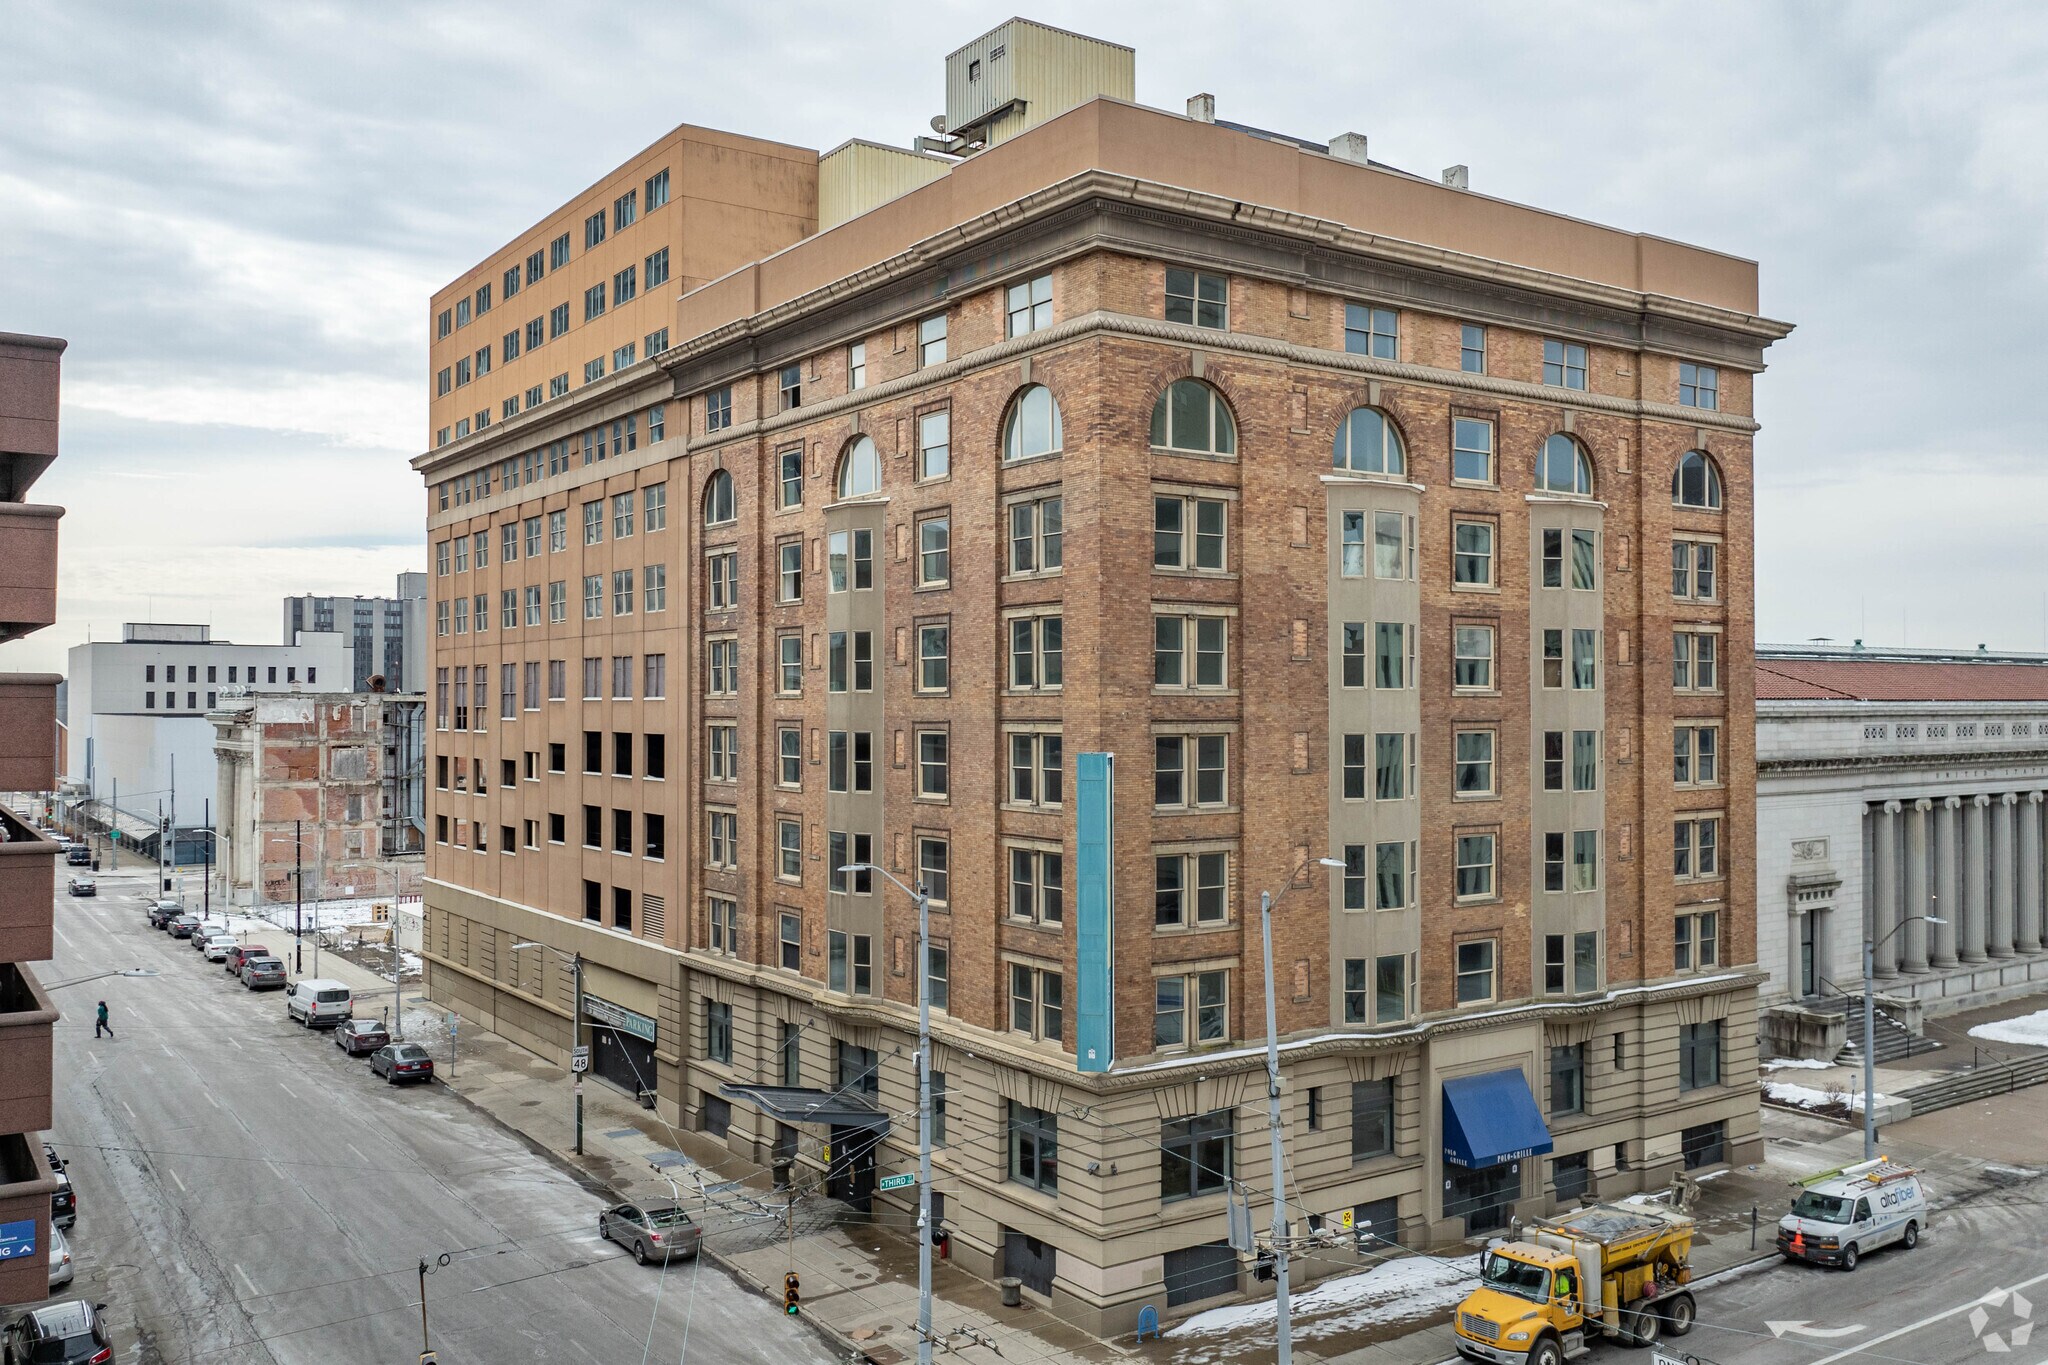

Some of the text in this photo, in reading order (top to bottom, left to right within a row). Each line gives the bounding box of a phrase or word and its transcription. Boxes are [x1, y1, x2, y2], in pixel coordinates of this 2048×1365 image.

[626, 1017, 653, 1037] PARKING
[574, 1058, 587, 1069] 48
[1444, 1147, 1457, 1156] POLO
[1449, 1156, 1468, 1167] GRILLE
[884, 1176, 906, 1187] THIRD
[1880, 1186, 1915, 1208] altafiber
